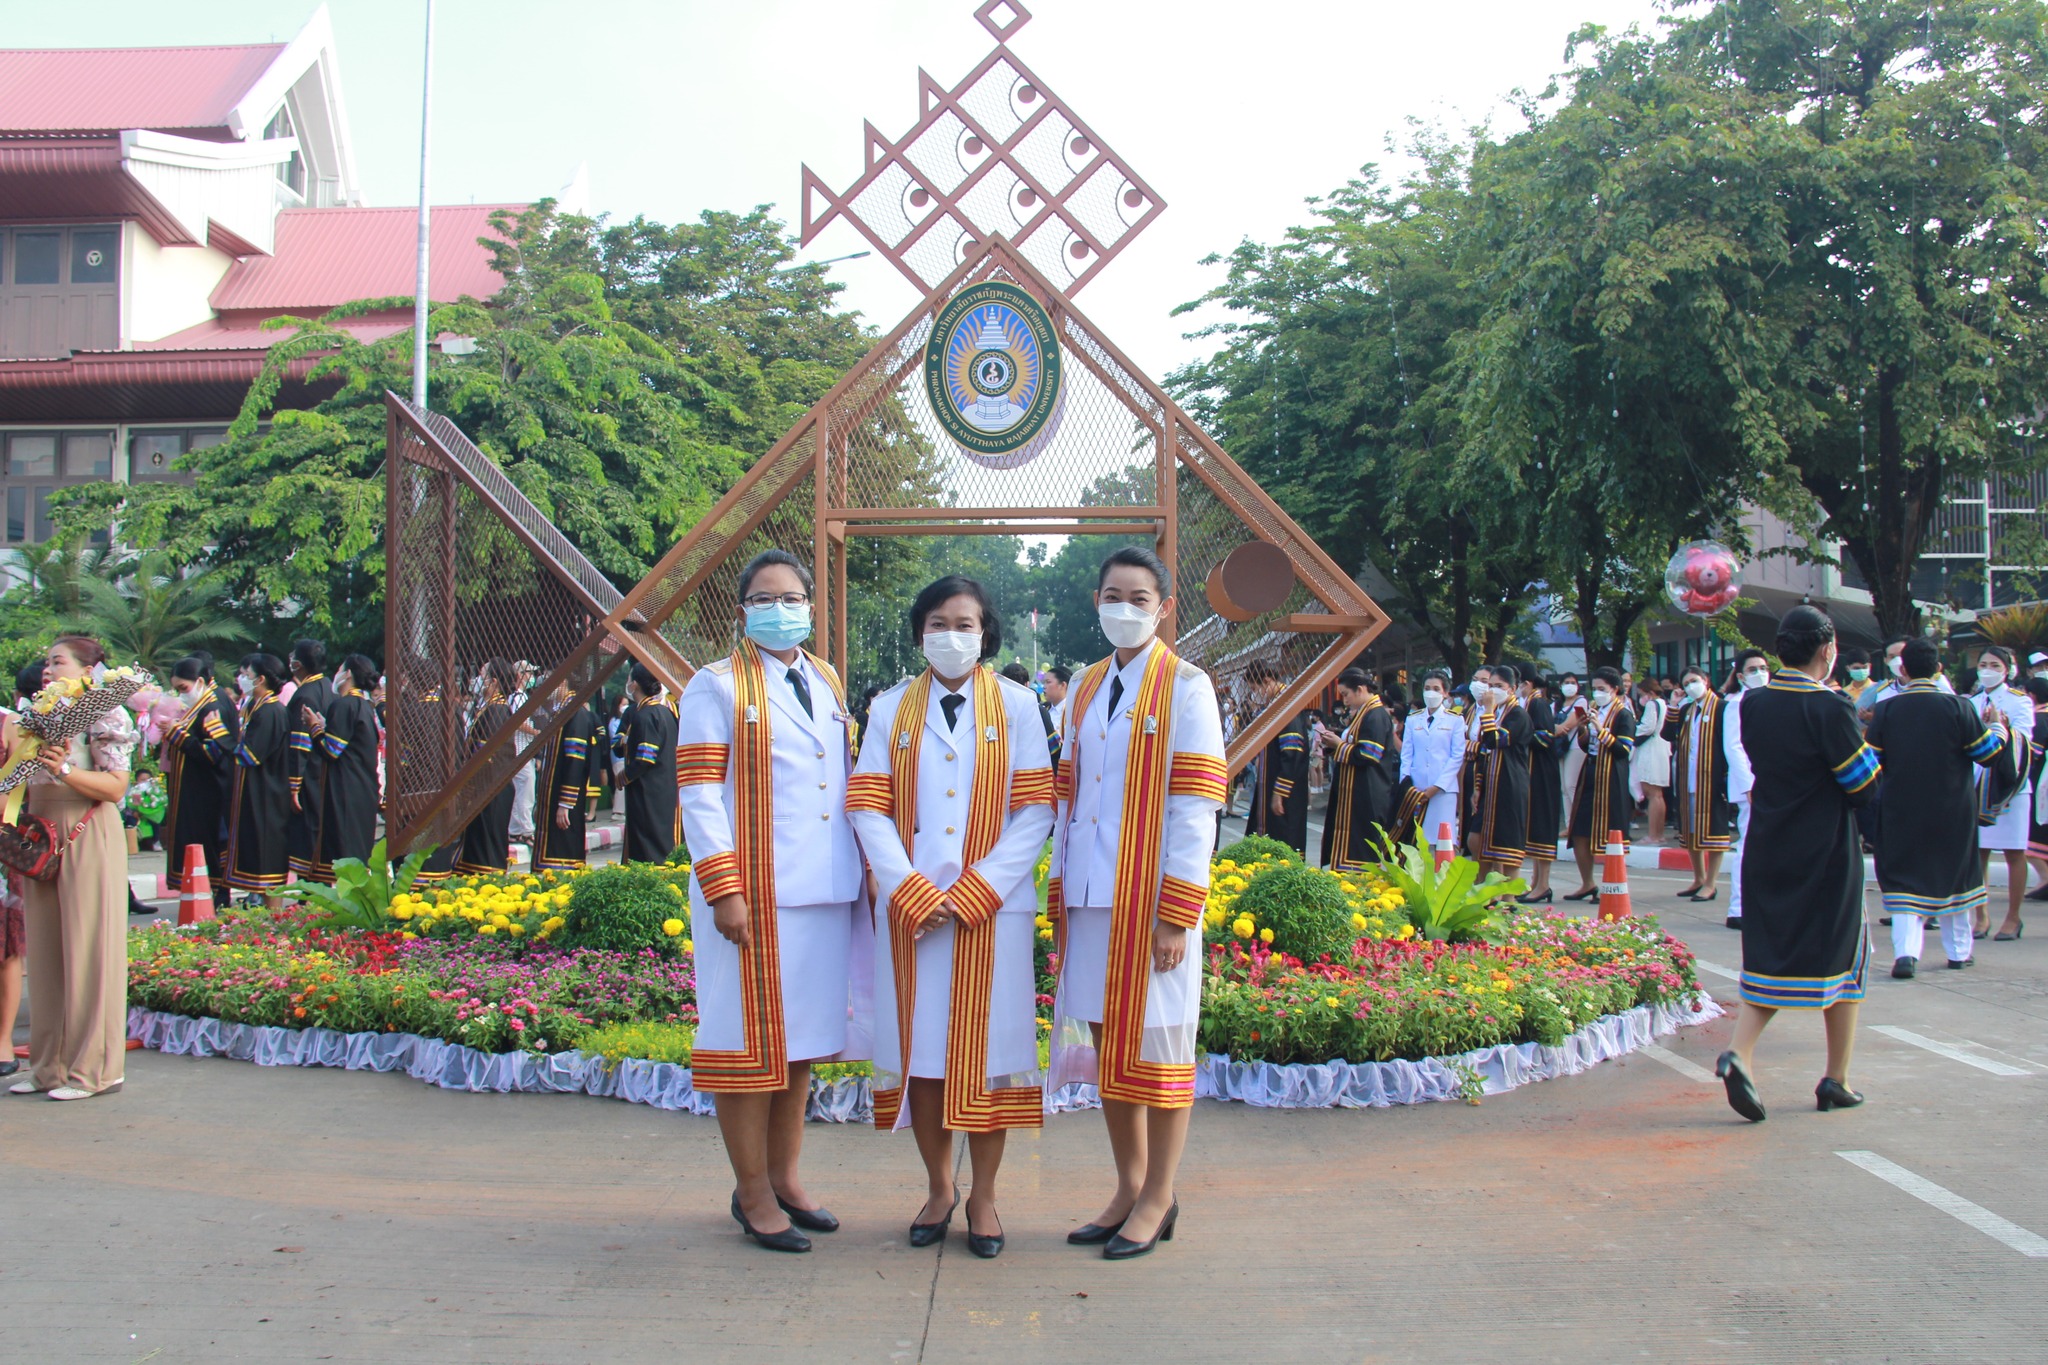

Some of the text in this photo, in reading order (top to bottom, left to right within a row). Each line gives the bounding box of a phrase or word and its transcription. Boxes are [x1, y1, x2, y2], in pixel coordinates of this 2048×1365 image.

[931, 369, 1055, 448] PHRANAKHON SI AYUTTHAYA RAJABHAT UNIVERSITY
